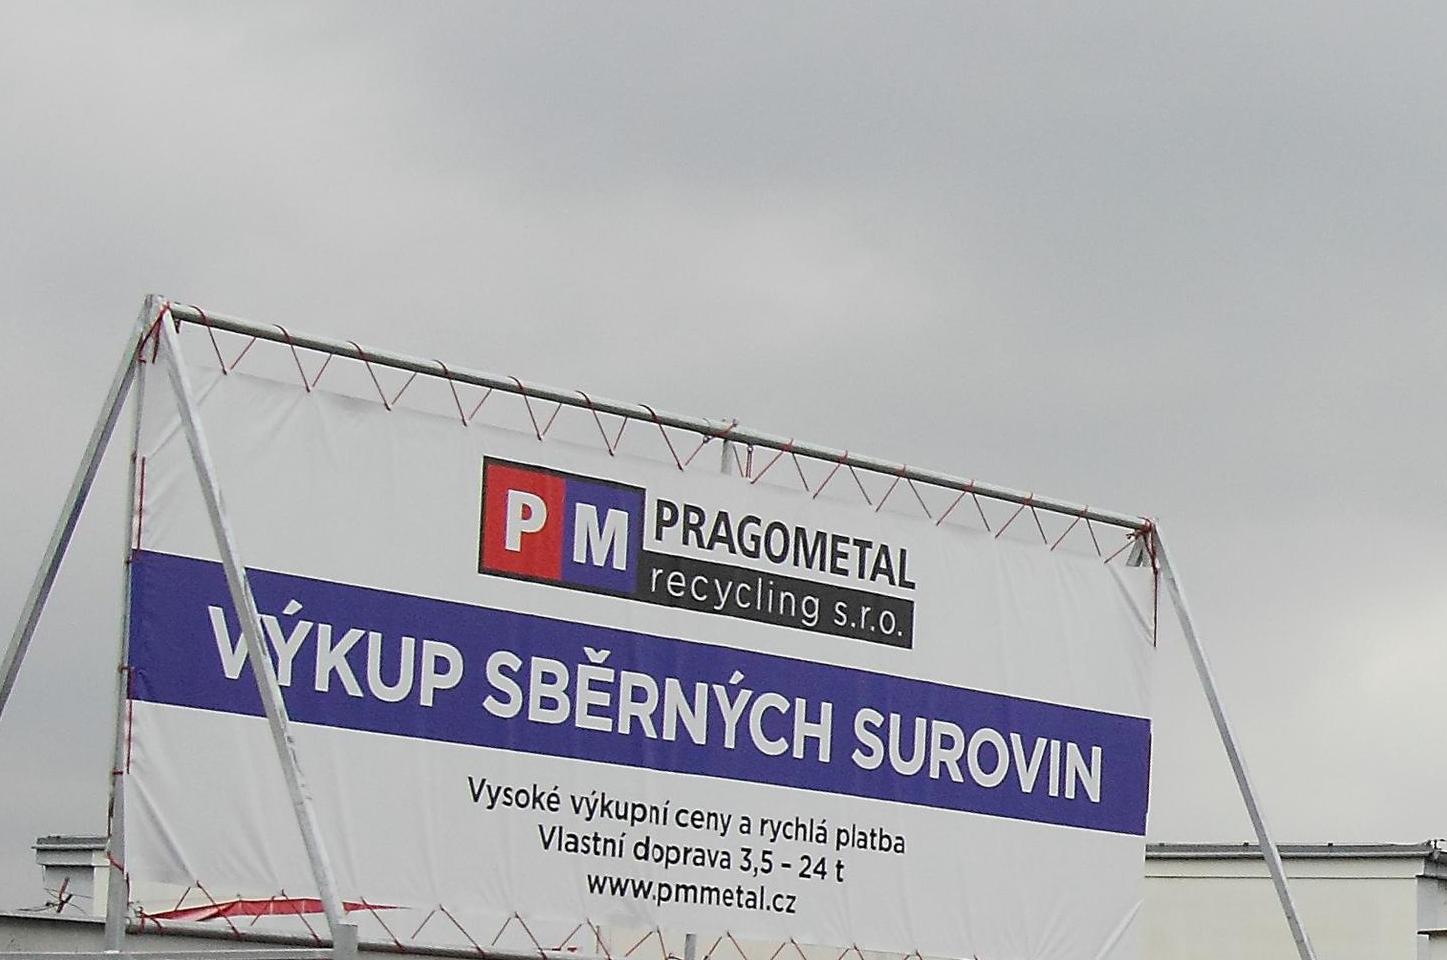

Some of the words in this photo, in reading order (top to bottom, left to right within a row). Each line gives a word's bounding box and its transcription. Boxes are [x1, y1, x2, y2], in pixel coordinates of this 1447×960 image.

[655, 499, 916, 590] PRAGOMETAL
[650, 566, 820, 627] recycling
[834, 600, 903, 637] s.r.o.
[208, 599, 465, 707] VÝKUP
[483, 647, 833, 763] SBĚRNÝCH
[852, 708, 1102, 803] SUROVIN
[468, 776, 561, 812] Vysoké
[570, 790, 670, 827] výkupní
[675, 808, 732, 836] ceny
[739, 816, 751, 834] a
[760, 816, 827, 843] rychlá
[836, 824, 905, 853] platba
[538, 824, 626, 858] Vlastní
[633, 836, 731, 869] doprava
[740, 848, 773, 877] 3,5
[799, 855, 827, 880] 24
[836, 860, 844, 882] t
[587, 874, 797, 914] www.pmmetal.cz
